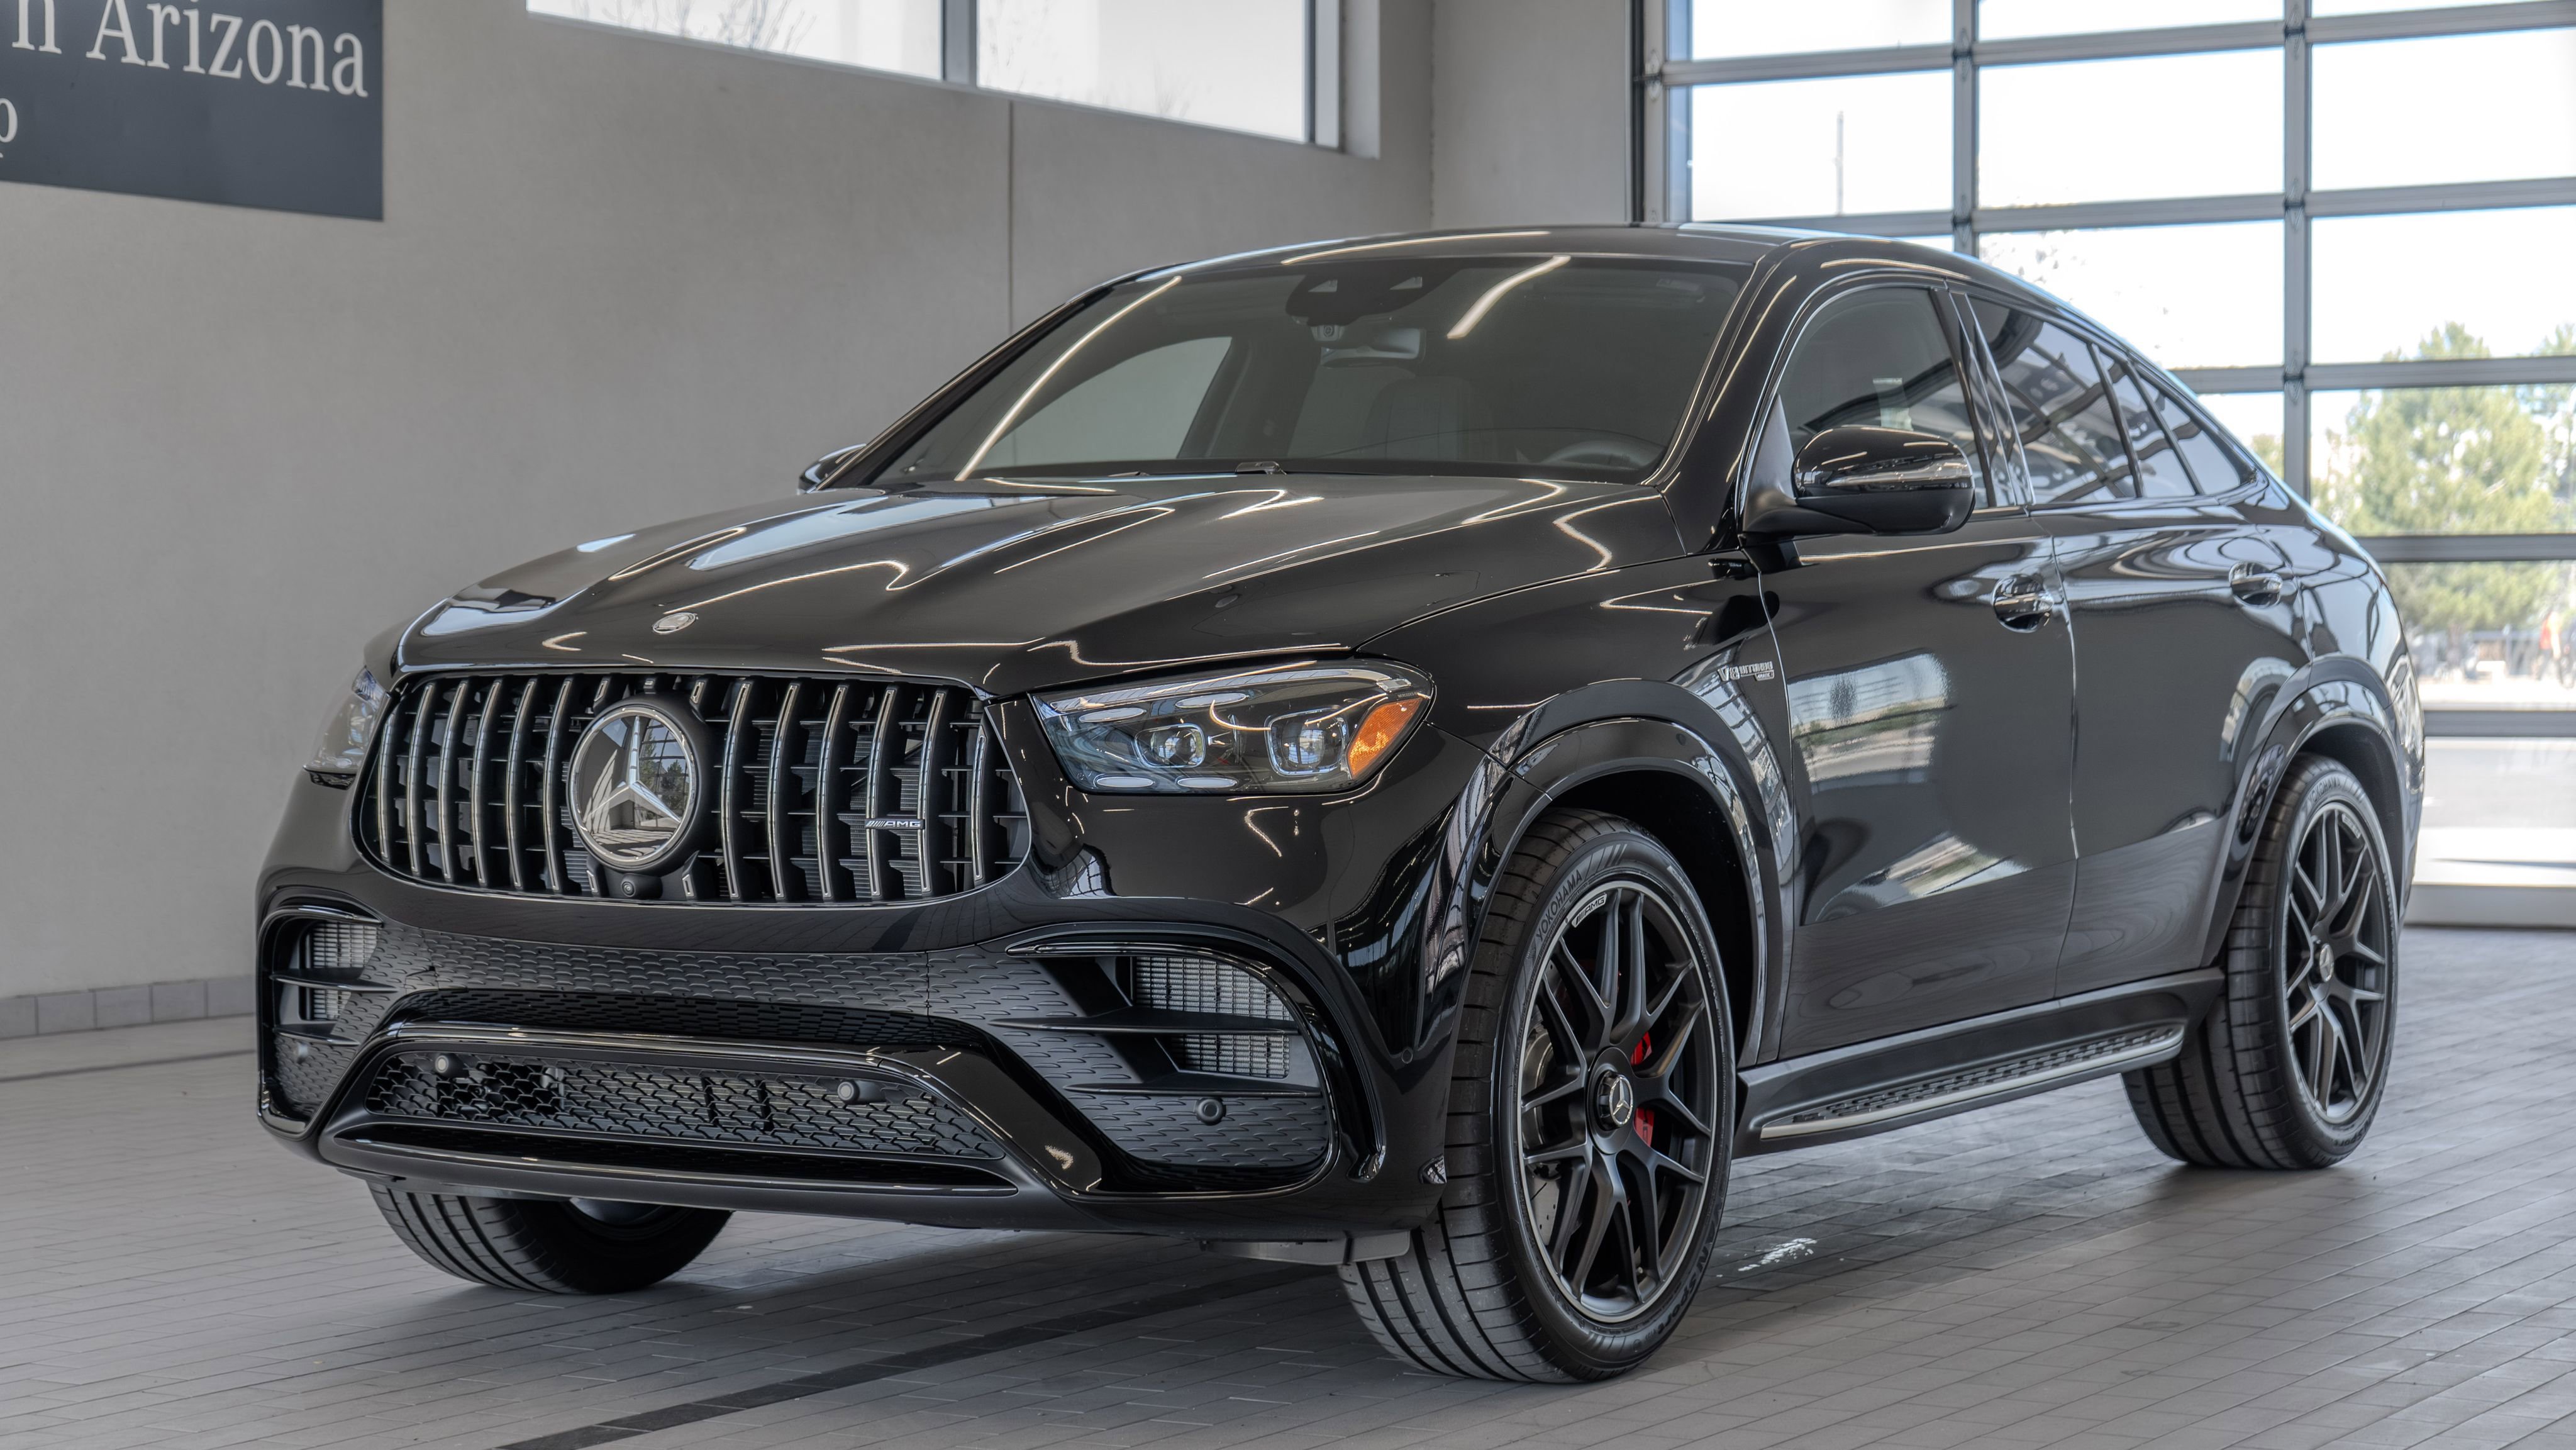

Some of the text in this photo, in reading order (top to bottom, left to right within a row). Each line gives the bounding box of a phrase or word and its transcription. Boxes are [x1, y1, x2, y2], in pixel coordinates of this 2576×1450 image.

[86, 0, 368, 97] Arizona
[1718, 665, 1740, 681] V8
[2307, 777, 2340, 801] YOKOHAMA
[1536, 869, 1582, 942] YOKOHAMA
